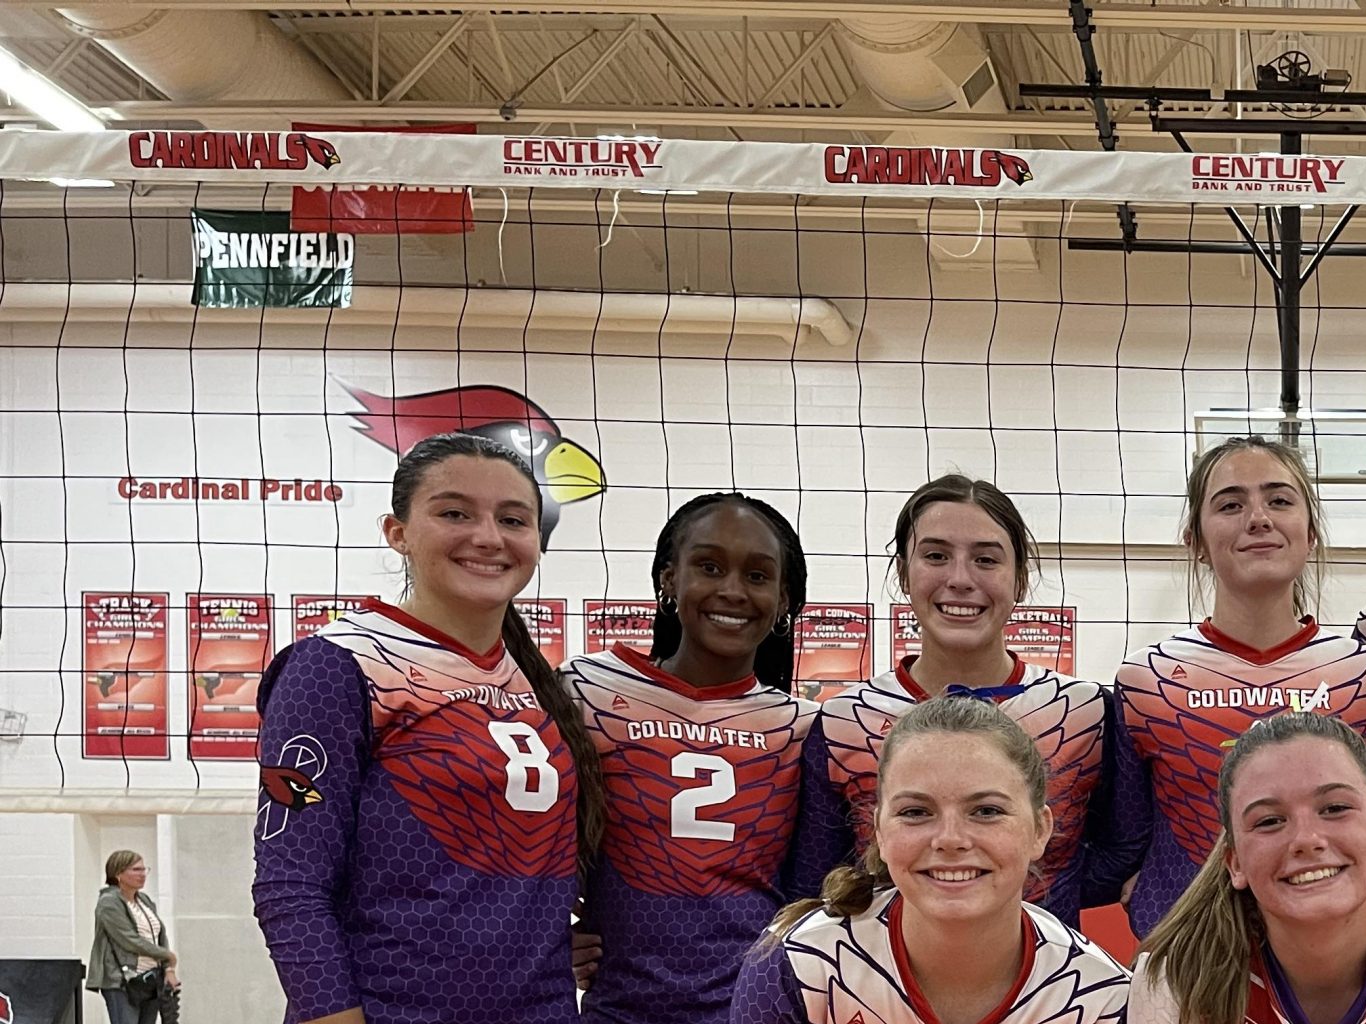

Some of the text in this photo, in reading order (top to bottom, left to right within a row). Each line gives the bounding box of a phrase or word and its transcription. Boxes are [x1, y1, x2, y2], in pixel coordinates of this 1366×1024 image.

[129, 131, 307, 170] CARDINALS
[504, 139, 662, 177] CENTURY
[504, 166, 628, 177] BANK AND TRUST
[824, 145, 1001, 187] CARDINALS
[1192, 156, 1345, 193] CENTURY
[1192, 181, 1311, 192] BANK AND TRUST
[197, 232, 355, 268] PENNFIELD
[118, 477, 343, 502] Cardinal Pride
[200, 598, 259, 617] TENNIS
[297, 599, 361, 619] SOFTBA
[588, 604, 657, 623] GYMNASTIC
[86, 620, 165, 629] CHAMPIONS
[191, 622, 269, 630] CHAMPIONS
[814, 624, 845, 632] GIRLS
[1008, 610, 1072, 629] SKETBALL
[588, 628, 655, 636] CHAMPION
[794, 631, 867, 640] CHAMPIONS
[626, 720, 769, 751] COLDWATER
[487, 720, 560, 812] 8
[670, 750, 737, 842] 2
